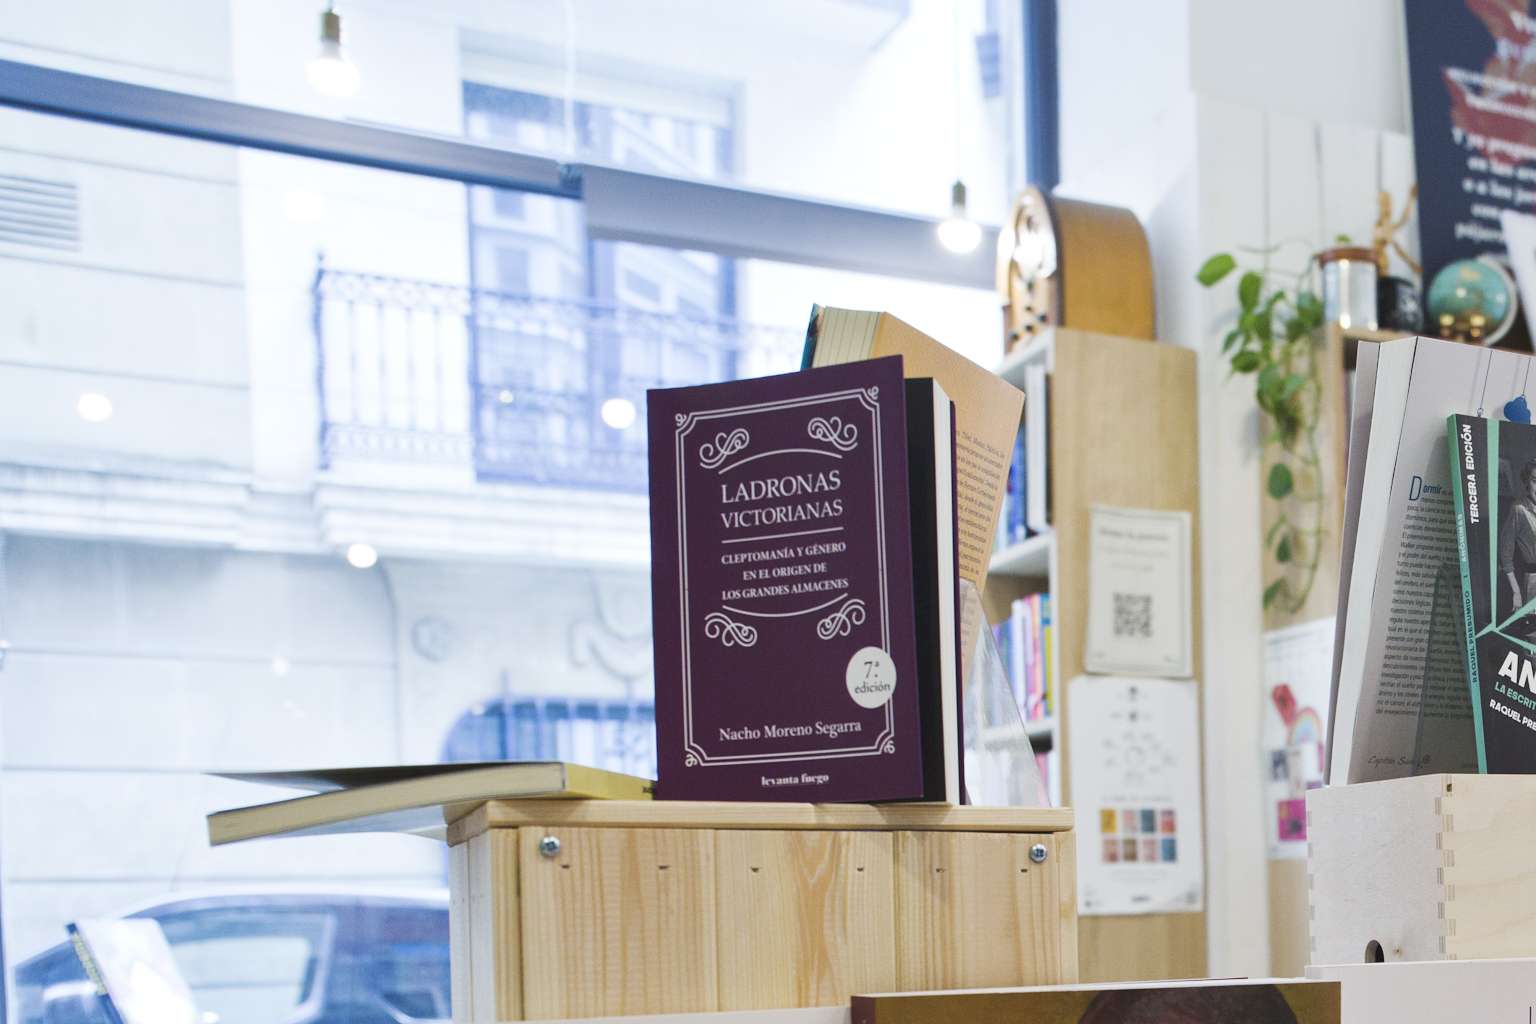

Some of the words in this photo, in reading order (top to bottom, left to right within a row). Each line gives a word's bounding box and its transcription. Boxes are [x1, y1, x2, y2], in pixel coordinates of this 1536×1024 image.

[1461, 424, 1475, 470] EDICIÓN
[721, 470, 841, 503] LADRONAS
[1467, 474, 1480, 524] TERCERA
[721, 499, 843, 528] VICTORIANAS
[721, 546, 796, 565] CLEPTOMANÍA
[797, 547, 805, 558] Y
[805, 542, 847, 556] GÉNERO
[743, 570, 757, 581] EN
[759, 569, 771, 580] EL
[772, 563, 812, 578] ORIGEN
[813, 562, 828, 574] DE
[722, 590, 741, 600] LOS
[742, 585, 790, 599] GRANDES
[791, 578, 849, 593] ALMACENES
[854, 680, 891, 694] edición
[1494, 681, 1505, 693] LA
[1489, 699, 1522, 724] RAQUEL
[719, 727, 761, 742] Nacho
[764, 723, 813, 739] Moreno
[815, 721, 863, 739] Segarra
[761, 774, 799, 787] levanta
[801, 773, 830, 785] fuego
